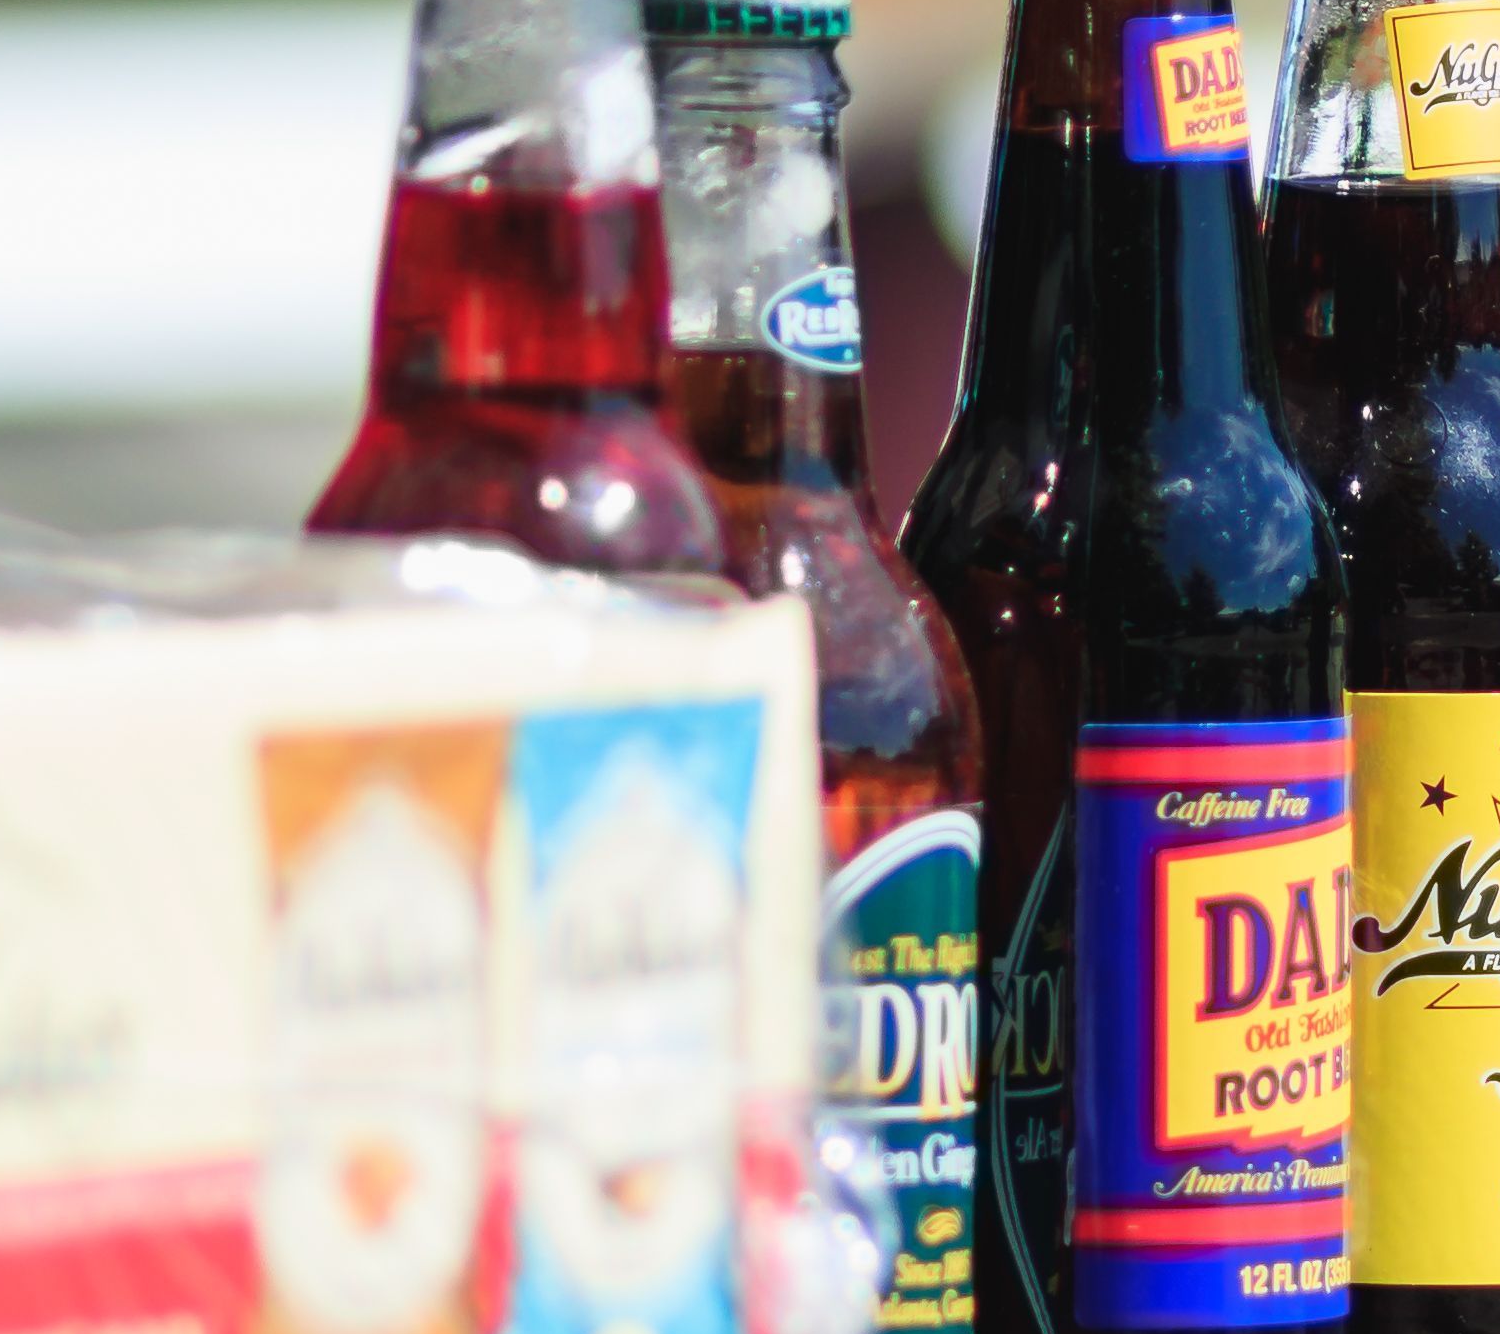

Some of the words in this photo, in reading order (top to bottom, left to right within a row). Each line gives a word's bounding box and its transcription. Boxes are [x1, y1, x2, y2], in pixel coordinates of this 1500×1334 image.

[1184, 113, 1227, 138] ROOT
[1155, 790, 1261, 828] Caffeine
[1265, 787, 1312, 820] Free
[1462, 954, 1476, 971] A
[1244, 1015, 1291, 1053] Old
[1214, 1050, 1328, 1118] ROOT
[1153, 1160, 1286, 1200] America's
[1240, 1264, 1269, 1296] 12
[1272, 1262, 1298, 1294] FL
[1301, 1259, 1323, 1292] OZ
